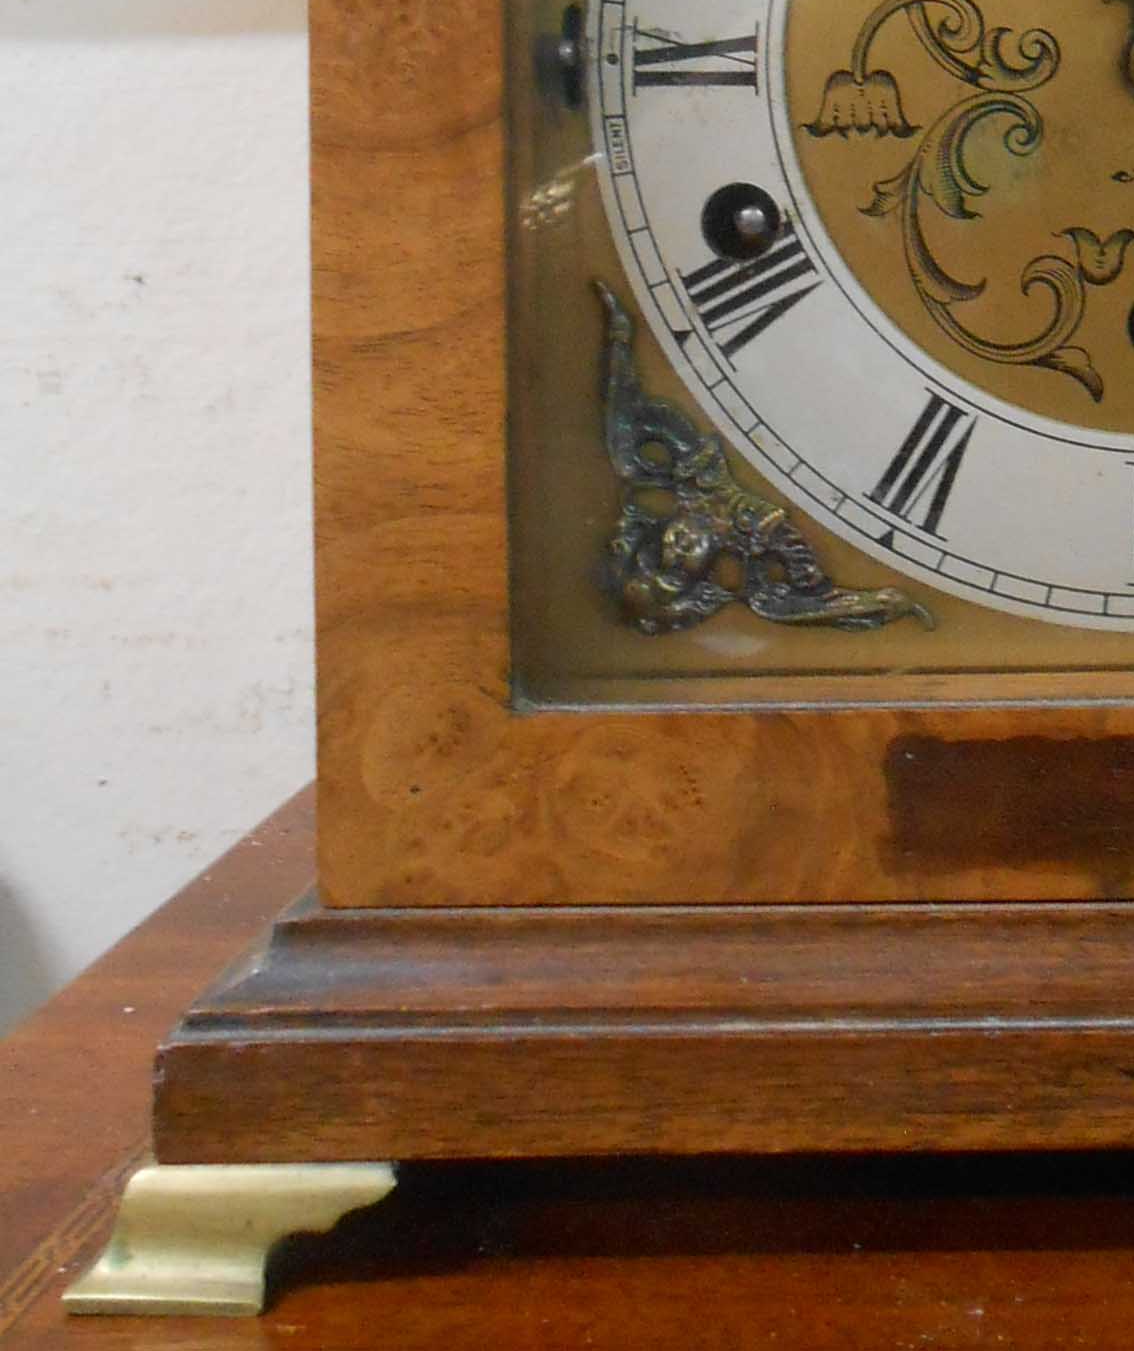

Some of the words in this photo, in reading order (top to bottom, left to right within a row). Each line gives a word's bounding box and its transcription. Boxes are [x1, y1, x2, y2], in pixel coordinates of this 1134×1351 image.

[632, 15, 759, 97] IX
[608, 122, 629, 171] SILENT
[862, 386, 979, 542] VII
